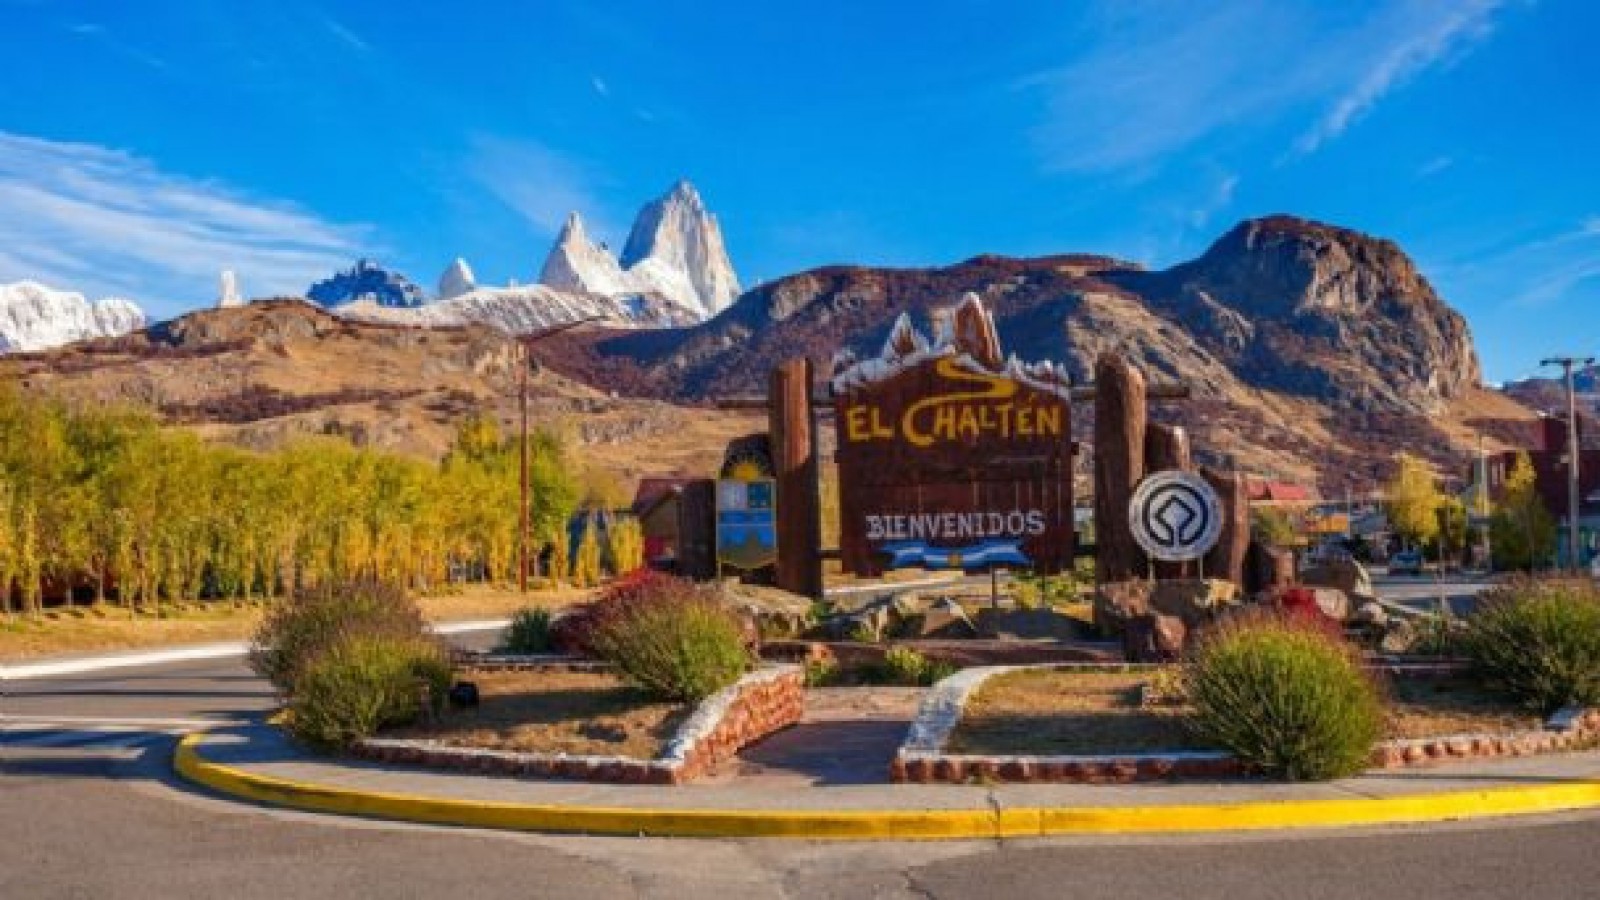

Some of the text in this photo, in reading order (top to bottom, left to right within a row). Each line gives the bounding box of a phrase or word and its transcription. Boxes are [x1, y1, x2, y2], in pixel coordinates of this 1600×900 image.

[847, 391, 1062, 447] EL CHALTÉN
[865, 508, 1046, 540] BIENVENIDOS
